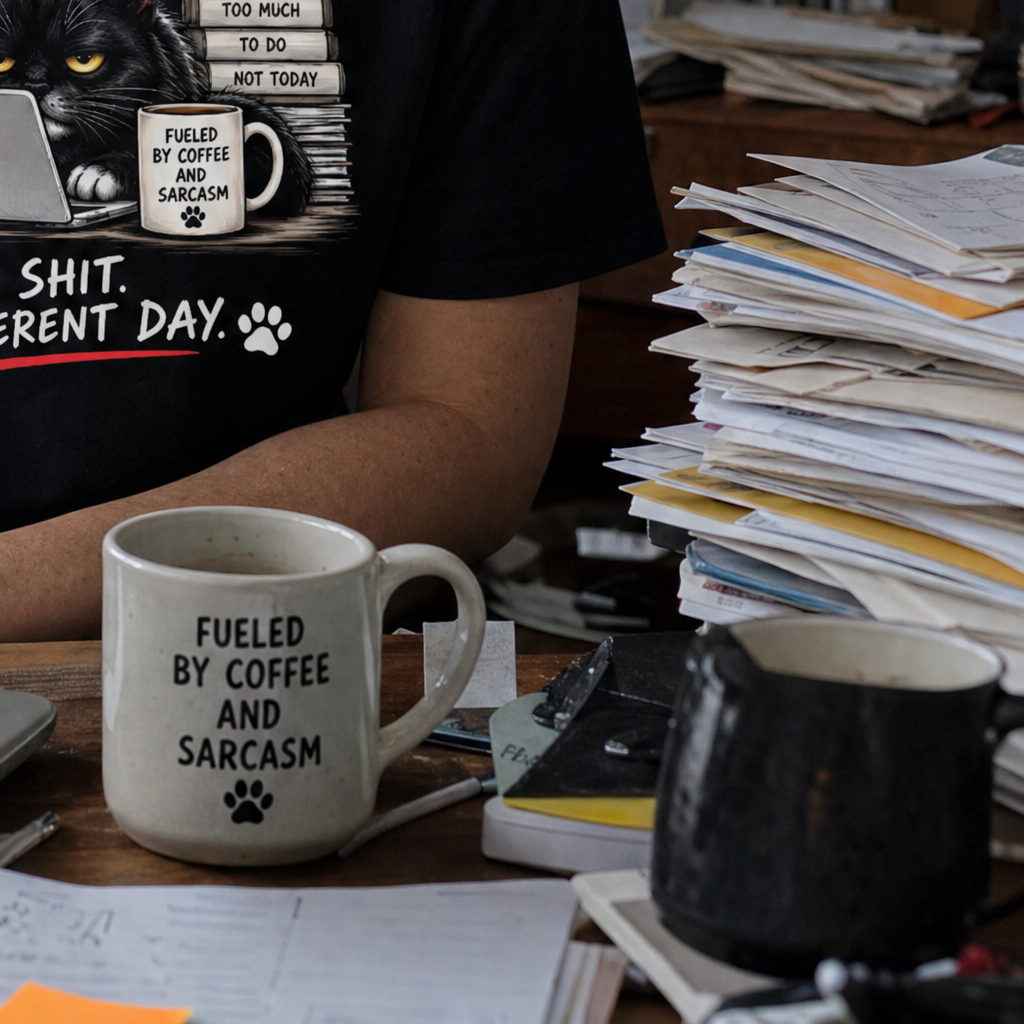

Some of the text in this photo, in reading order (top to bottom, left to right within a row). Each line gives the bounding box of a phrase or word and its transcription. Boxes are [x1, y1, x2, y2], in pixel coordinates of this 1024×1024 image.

[221, 2, 301, 18] TOO MUCH
[239, 36, 287, 53] TO DO
[233, 70, 318, 88] NOT TODAY
[165, 126, 219, 144] FUELED
[152, 145, 230, 164] BY COFFEE
[175, 167, 207, 183] AND
[157, 184, 229, 203] SARCASM
[18, 254, 127, 300] SHIT.
[136, 296, 226, 343] DAY.
[196, 615, 305, 648] FUELED
[173, 651, 330, 690] BY COFFEE
[216, 698, 282, 731] AND
[177, 734, 322, 772] SARCASM
